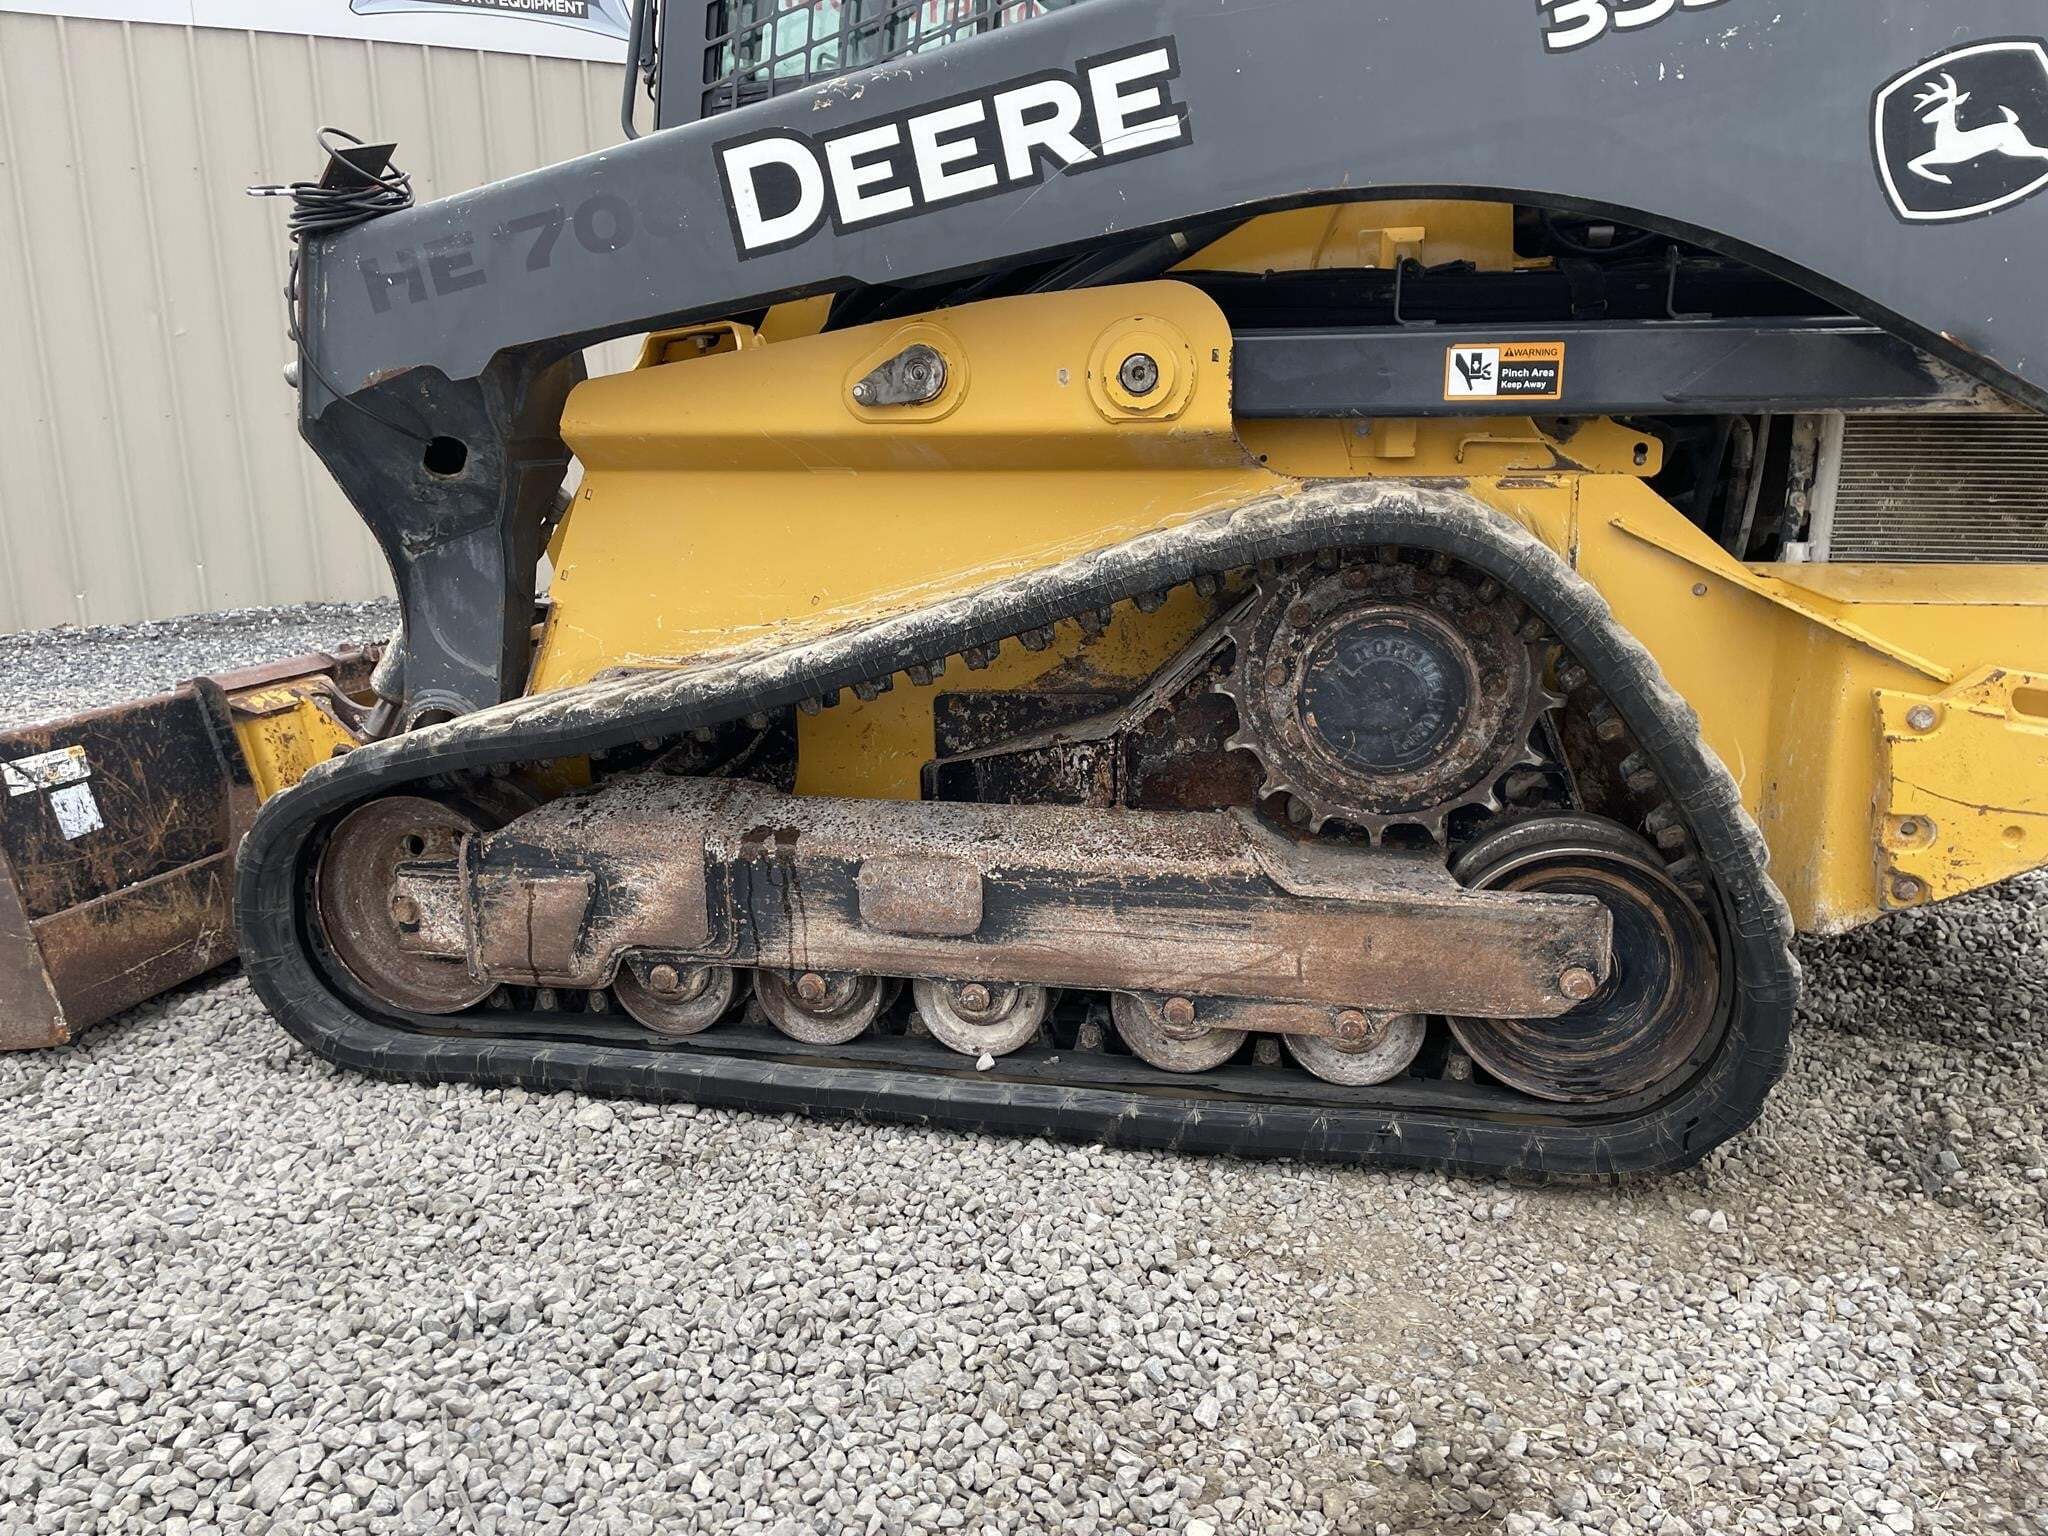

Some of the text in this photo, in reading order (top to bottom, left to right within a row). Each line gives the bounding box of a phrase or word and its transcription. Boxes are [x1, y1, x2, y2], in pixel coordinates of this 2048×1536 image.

[499, 0, 584, 15] EQUIPMENT
[722, 47, 1183, 251] DEERE
[1513, 348, 1558, 357] WARNING
[1502, 368, 1555, 378] Pinch Area
[1500, 380, 1547, 391] Keep Away
